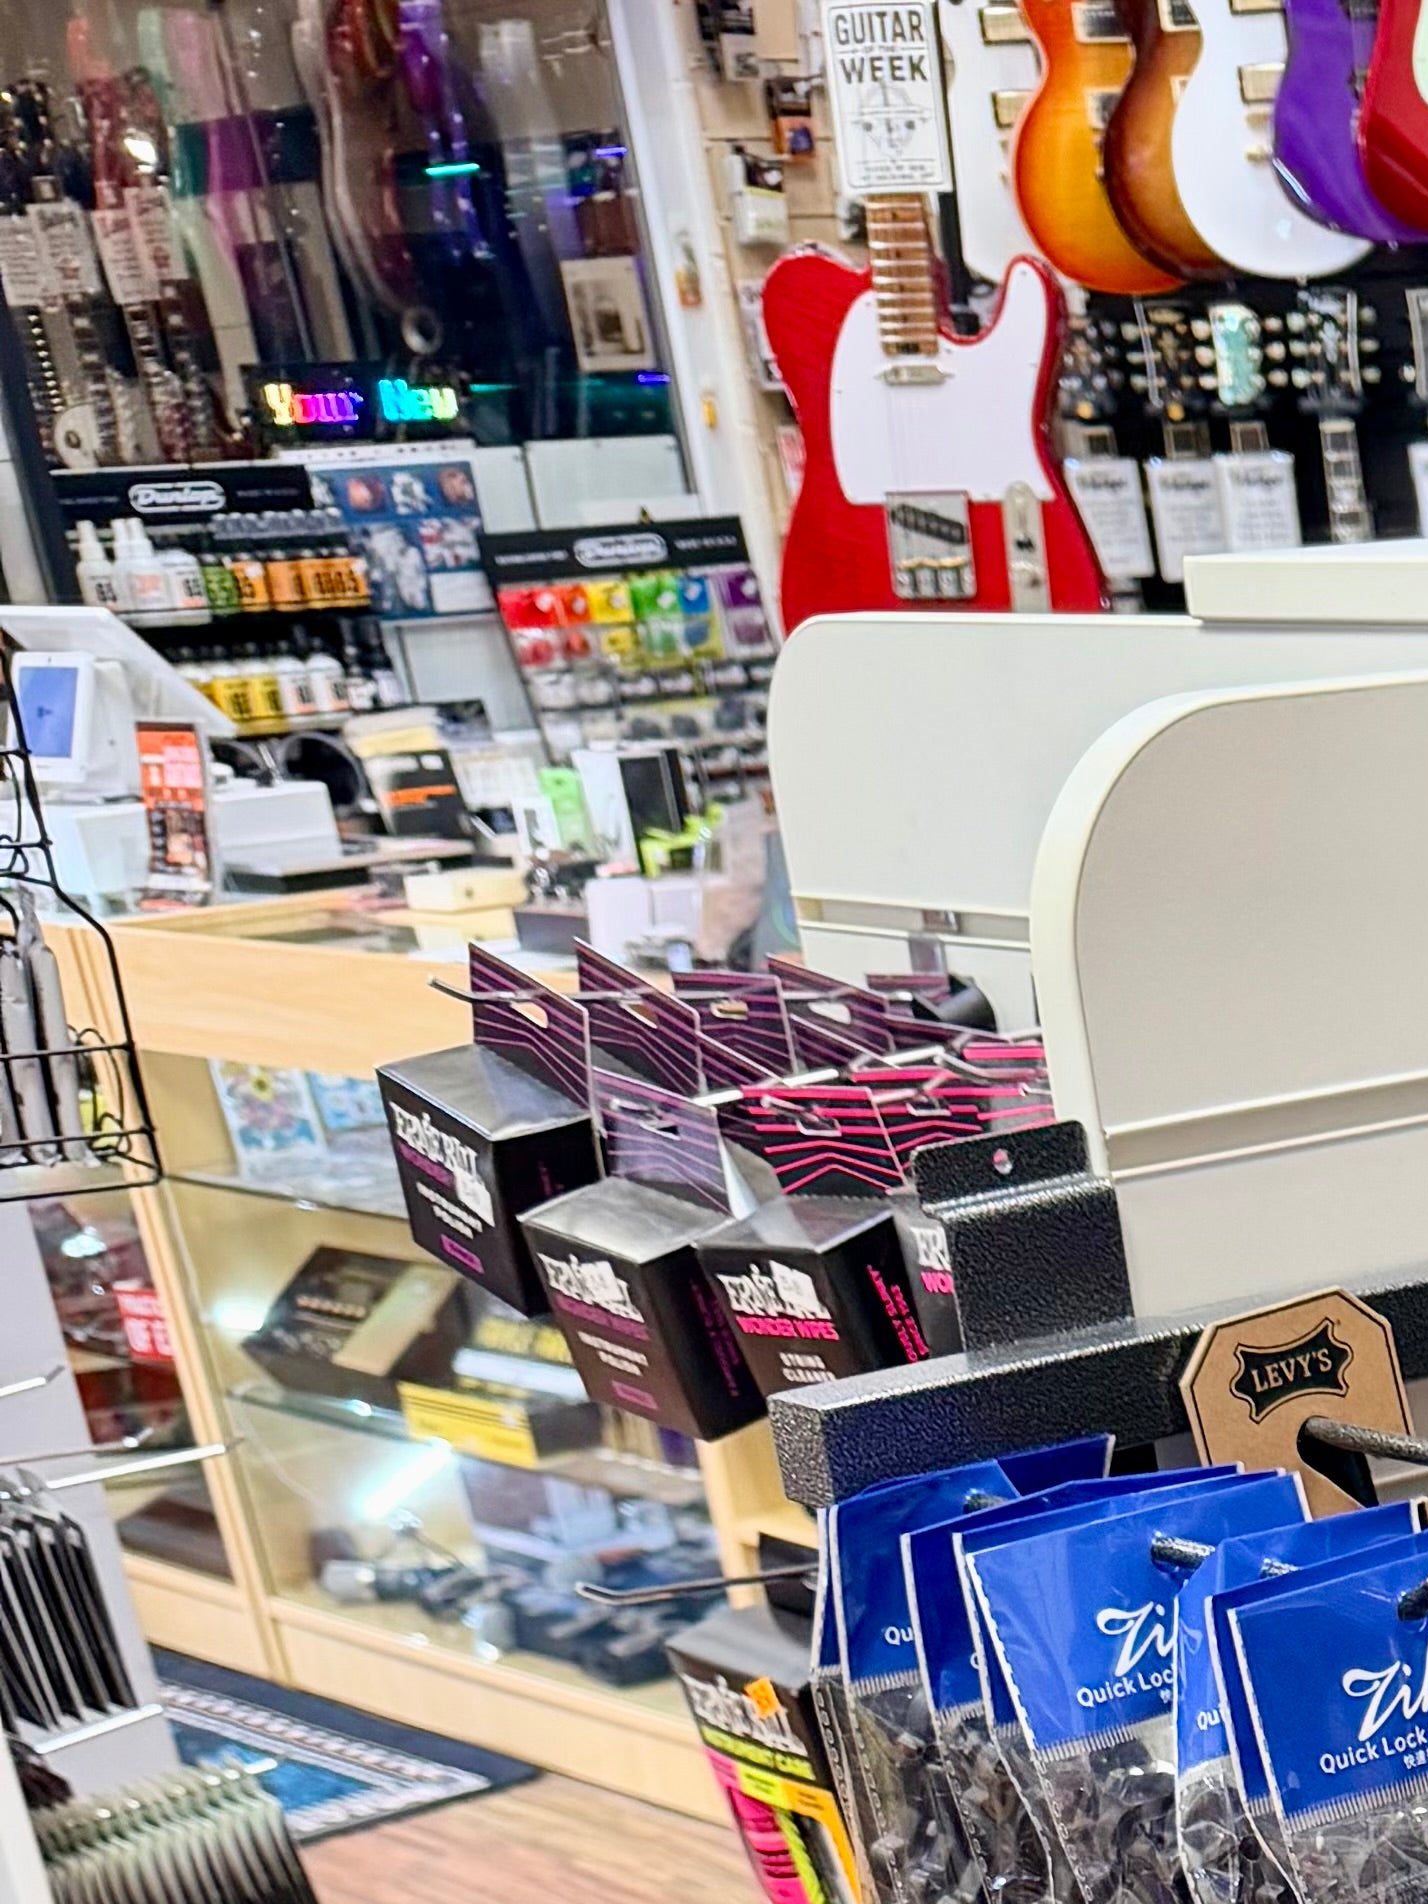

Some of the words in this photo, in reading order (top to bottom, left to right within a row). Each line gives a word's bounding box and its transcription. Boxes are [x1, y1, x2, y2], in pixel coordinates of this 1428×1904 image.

[835, 11, 924, 45] GUITAR
[840, 55, 928, 84] WEEK
[263, 383, 364, 425] Your
[378, 379, 459, 422] New
[736, 1316, 797, 1339] WONDER
[795, 1319, 840, 1341] WIPES
[1251, 1348, 1333, 1394] LEVY'S
[1077, 1677, 1137, 1708] Quick
[1139, 1664, 1175, 1691] Loc
[1320, 1738, 1380, 1775] Quick
[1382, 1723, 1428, 1756] Lock
